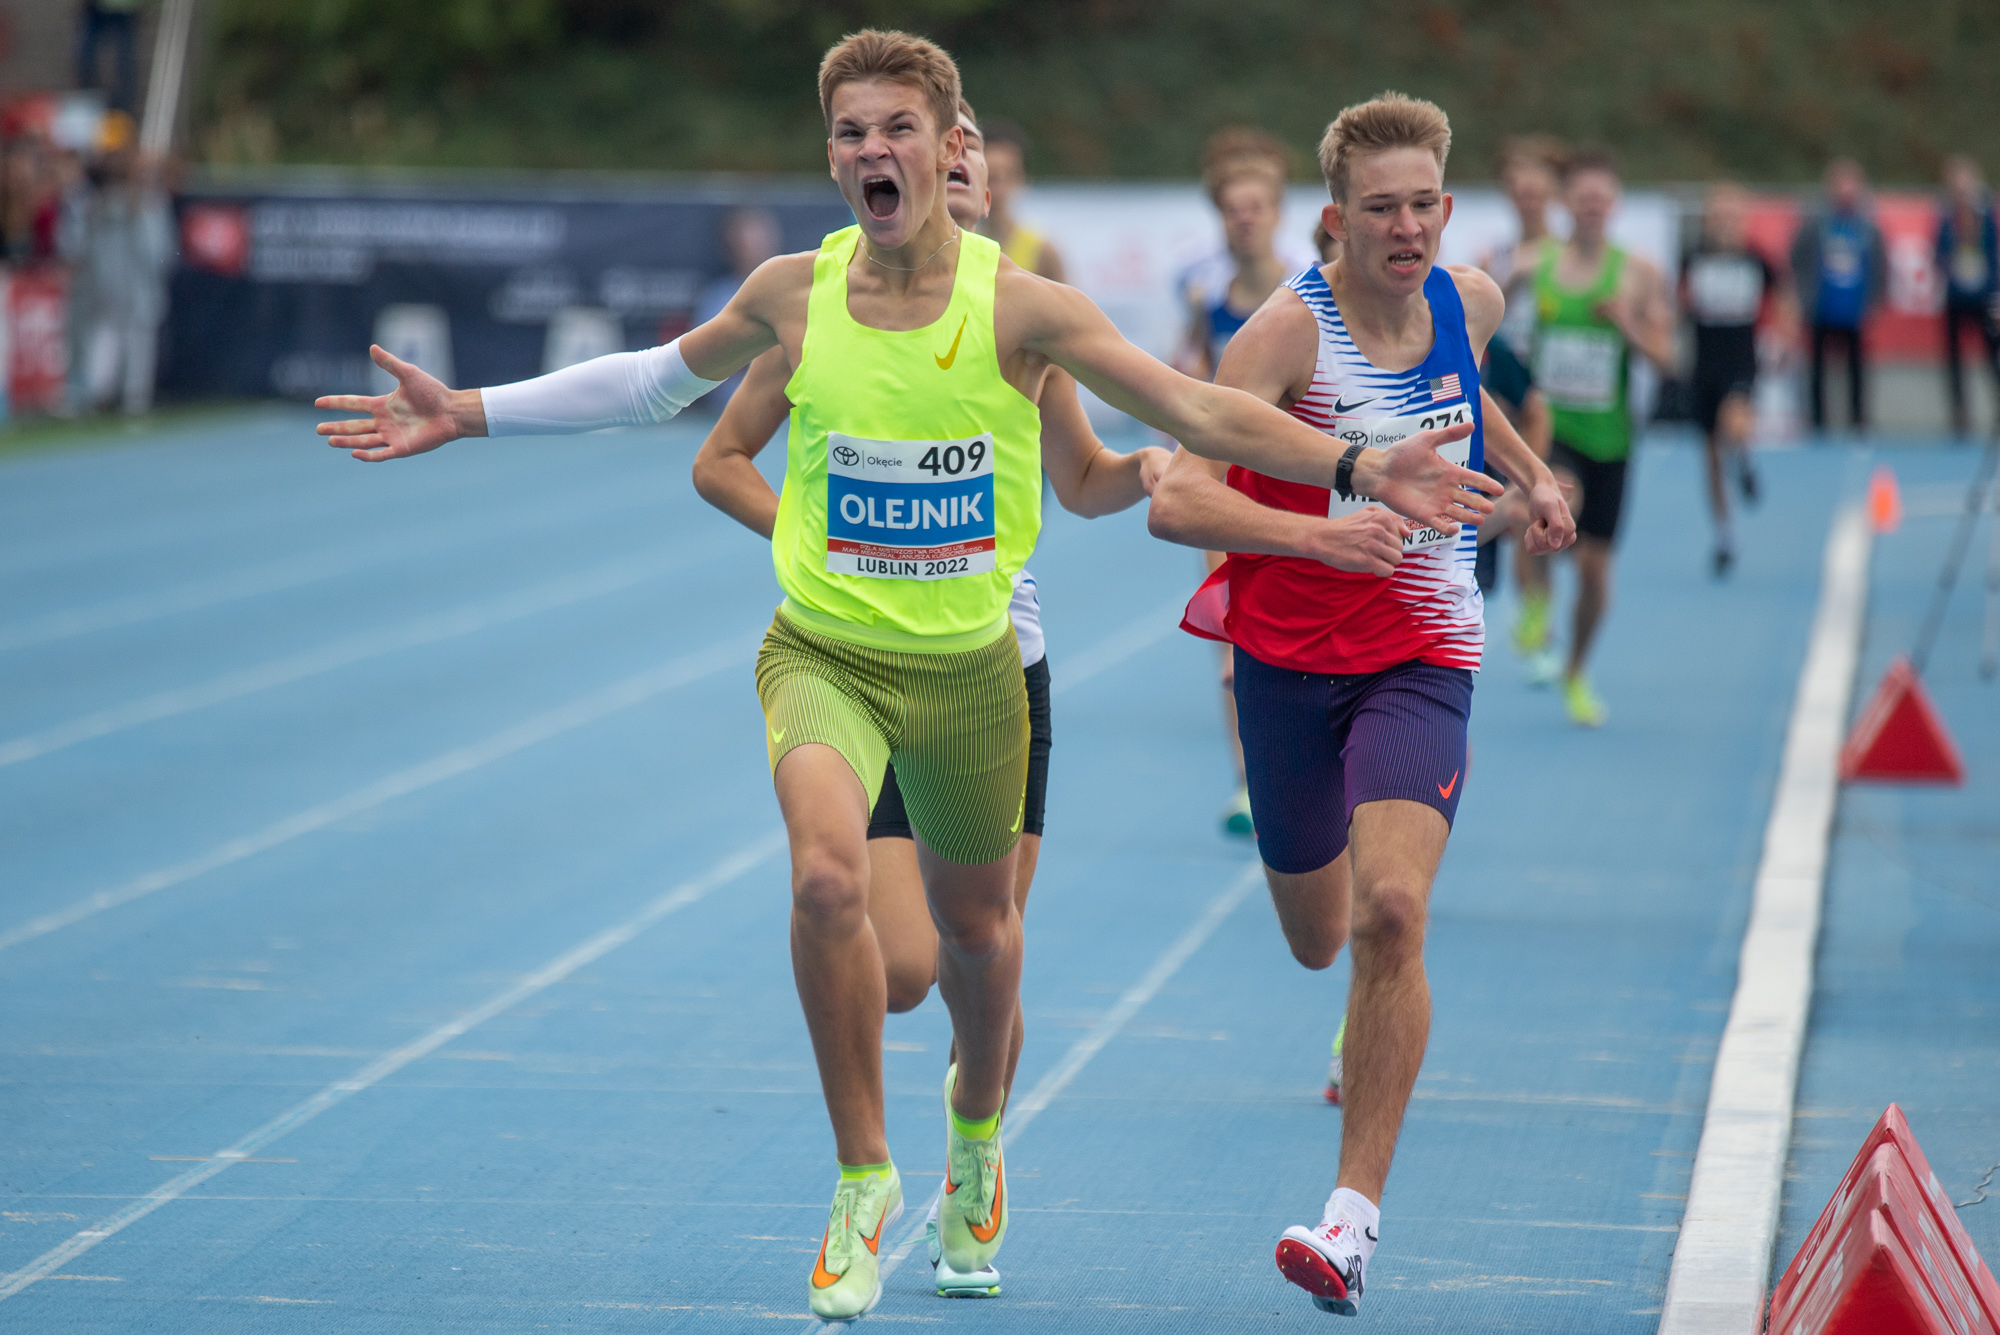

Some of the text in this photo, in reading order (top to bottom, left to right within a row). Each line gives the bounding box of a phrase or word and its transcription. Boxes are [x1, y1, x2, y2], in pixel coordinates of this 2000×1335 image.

[867, 456, 902, 467] Okęcie
[917, 440, 986, 476] 409
[839, 491, 984, 530] OLEJNIK
[857, 557, 969, 576] LUBLIN 2022
